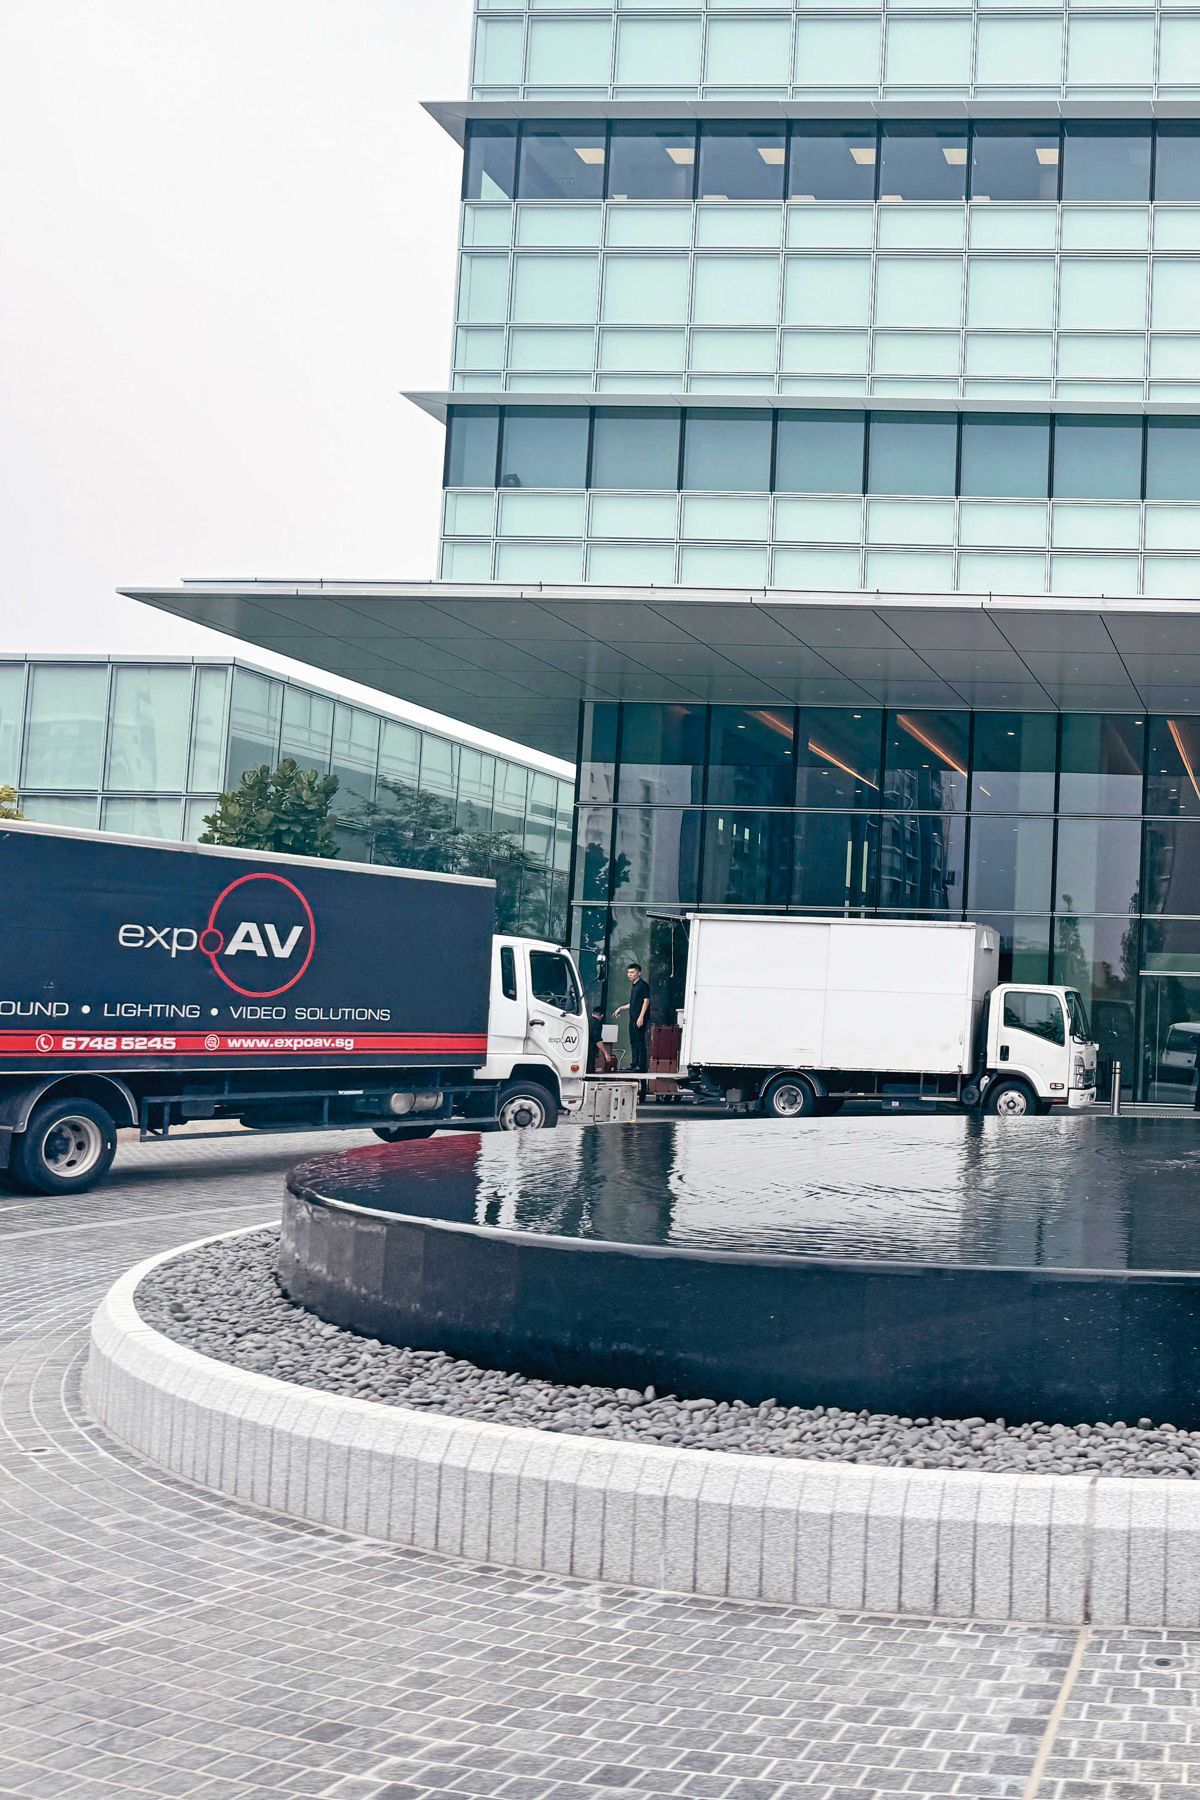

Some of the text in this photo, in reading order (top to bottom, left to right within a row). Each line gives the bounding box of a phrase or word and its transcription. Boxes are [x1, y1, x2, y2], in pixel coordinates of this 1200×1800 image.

[224, 921, 304, 959] AV
[104, 1003, 200, 1018] LIGHTING
[230, 1006, 286, 1020] VIDEO
[294, 1008, 391, 1021] SOLUTIONS
[61, 1037, 177, 1050] 6748 5245
[227, 1037, 354, 1050] www.expoav.sg
